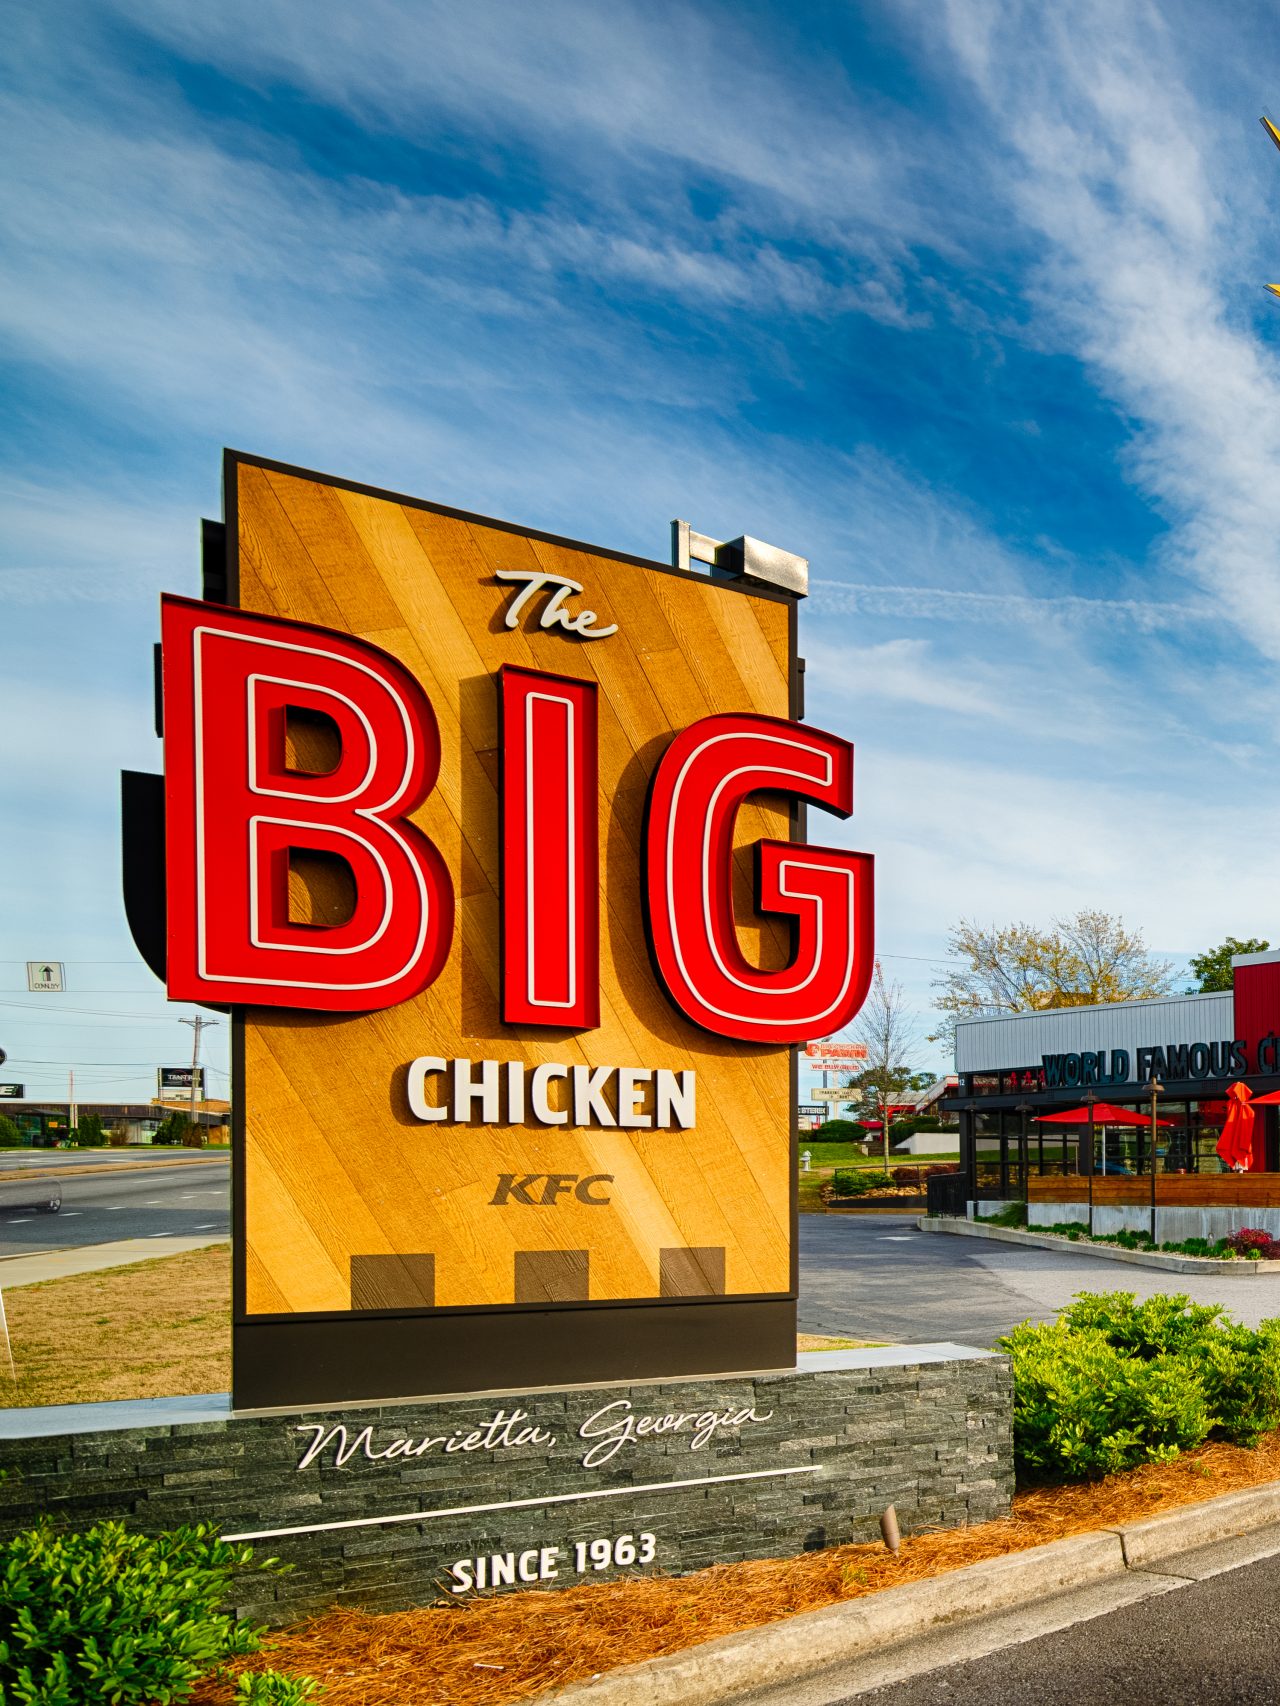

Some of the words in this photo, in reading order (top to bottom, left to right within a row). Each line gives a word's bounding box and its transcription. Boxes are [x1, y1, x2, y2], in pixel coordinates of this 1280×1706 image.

[496, 569, 619, 638] The
[161, 593, 876, 1044] BIG
[407, 1055, 697, 1129] CHICKEN
[1041, 1049, 1130, 1088] WORLD
[1136, 1040, 1247, 1081] FAMOUS
[488, 1173, 615, 1206] KFC
[296, 1408, 557, 1470] Marietta,
[578, 1399, 774, 1469] Georgia
[451, 1546, 560, 1594] SINCE
[574, 1532, 657, 1574] 1963
